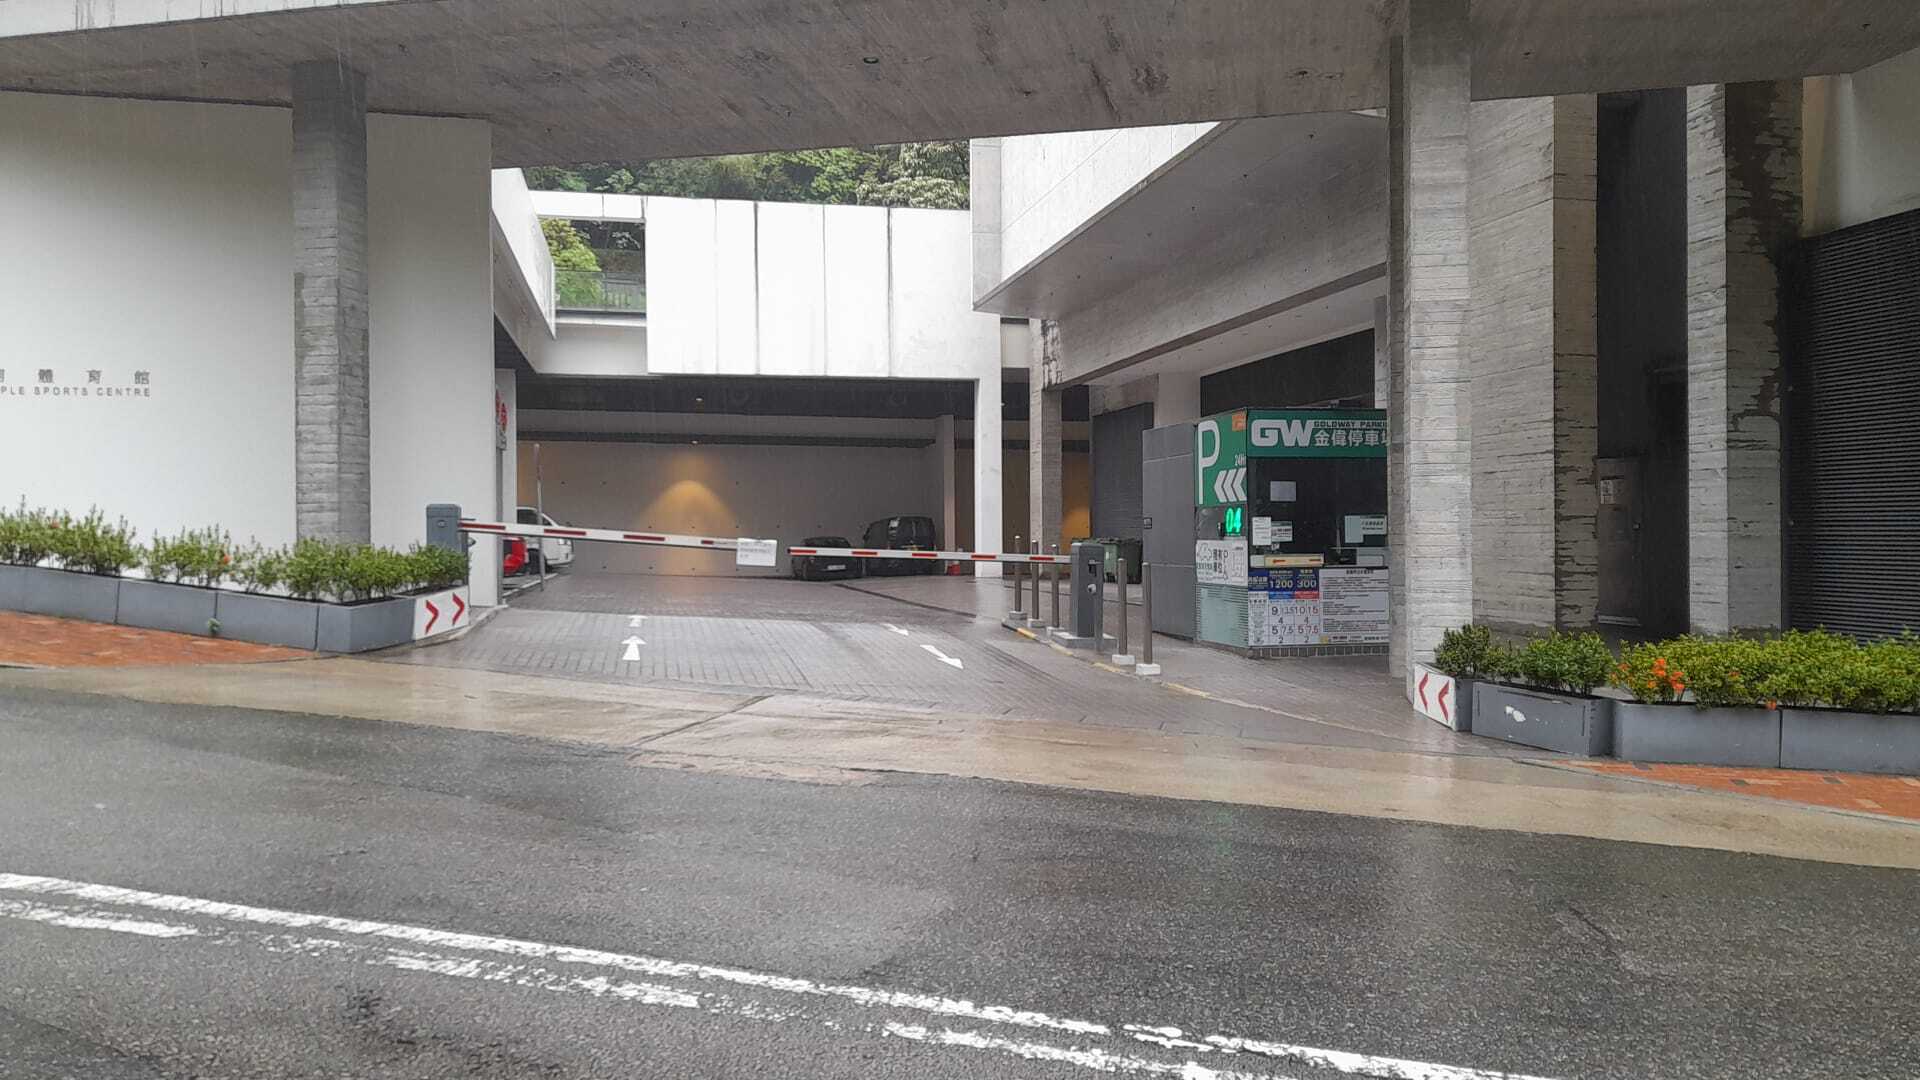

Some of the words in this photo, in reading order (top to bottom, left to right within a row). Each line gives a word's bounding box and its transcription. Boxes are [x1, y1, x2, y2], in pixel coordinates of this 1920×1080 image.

[34, 386, 89, 396] SPORTS
[96, 387, 151, 397] CENTRE
[1313, 420, 1356, 428] GOLDWAY
[1251, 419, 1315, 447] GW
[1197, 419, 1221, 505] P
[1225, 507, 1242, 533] 04
[1270, 580, 1294, 589] 1200
[1297, 579, 1318, 589] 300
[1271, 606, 1279, 615] 9
[1278, 616, 1284, 625] 4
[1303, 616, 1309, 625] 4
[1271, 625, 1279, 635] 5
